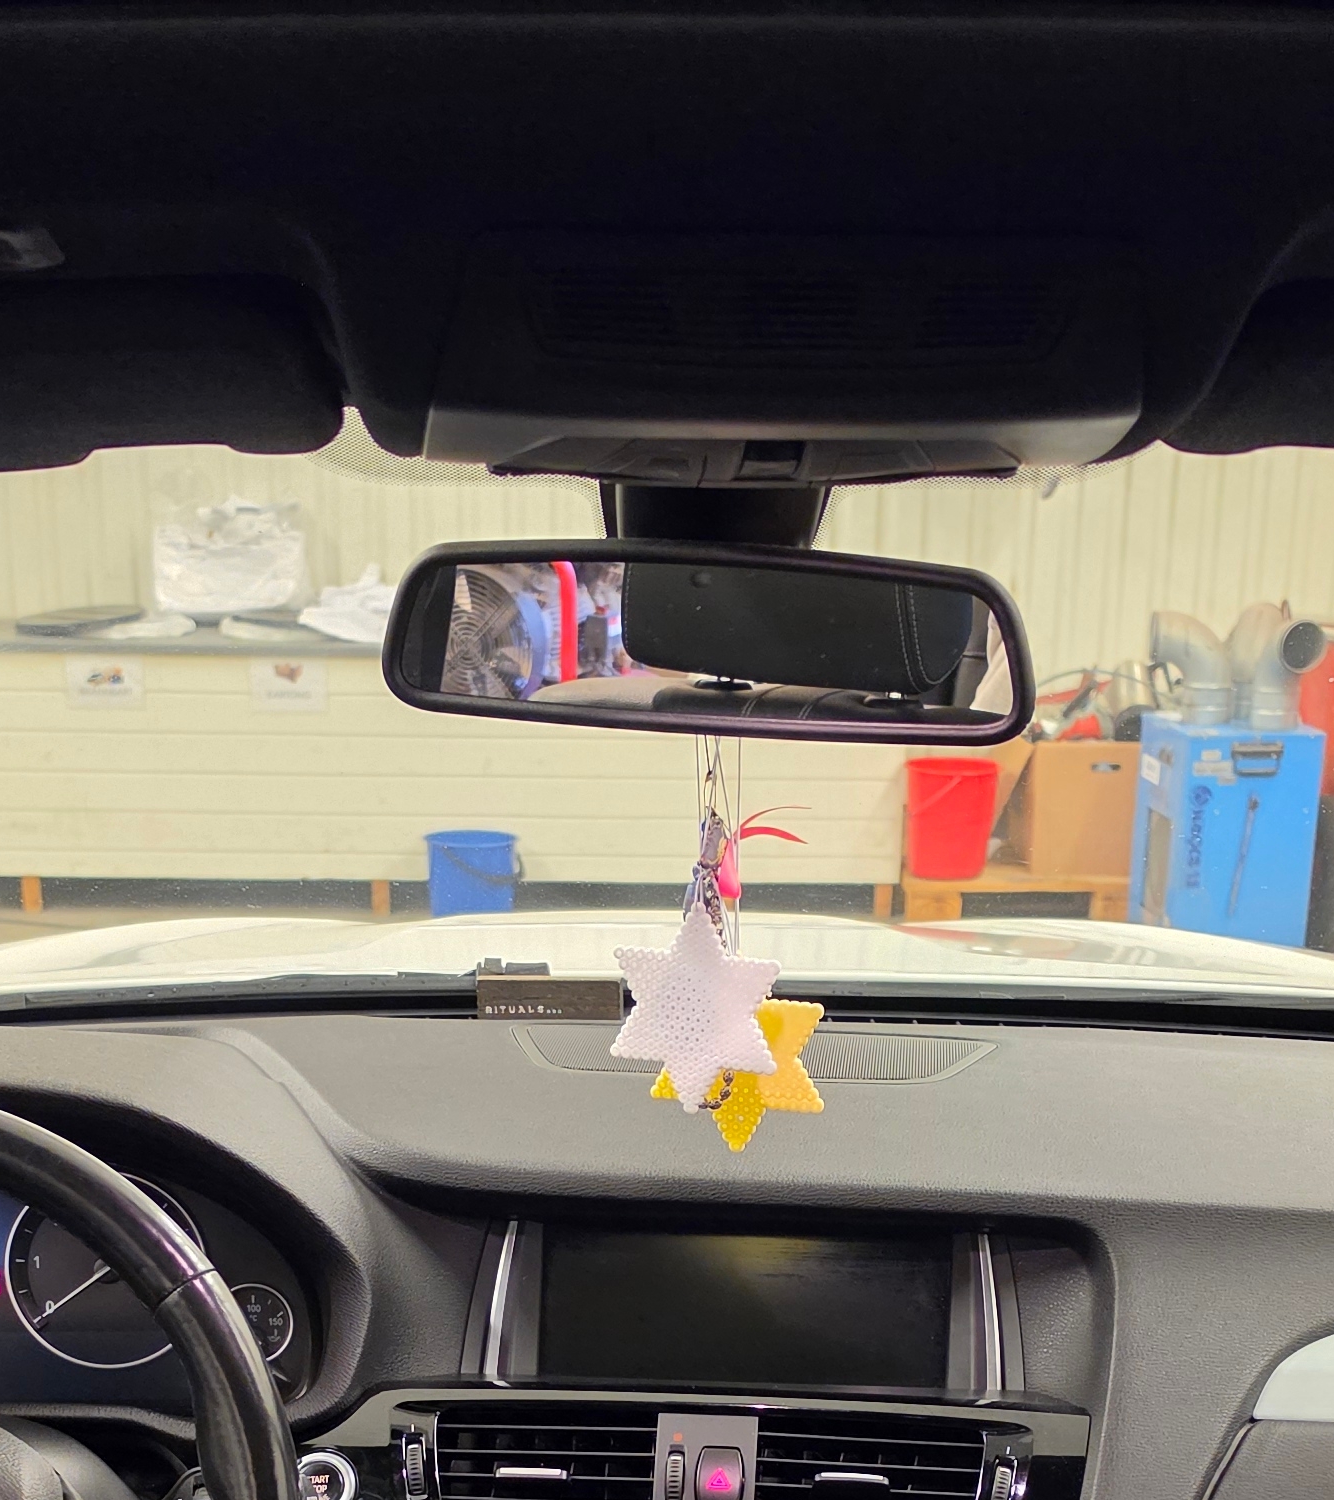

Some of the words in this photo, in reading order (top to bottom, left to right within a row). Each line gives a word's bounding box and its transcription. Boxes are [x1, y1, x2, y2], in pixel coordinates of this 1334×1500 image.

[247, 1304, 262, 1313] 100
[268, 1317, 284, 1326] 150
[307, 1474, 330, 1484] TART
